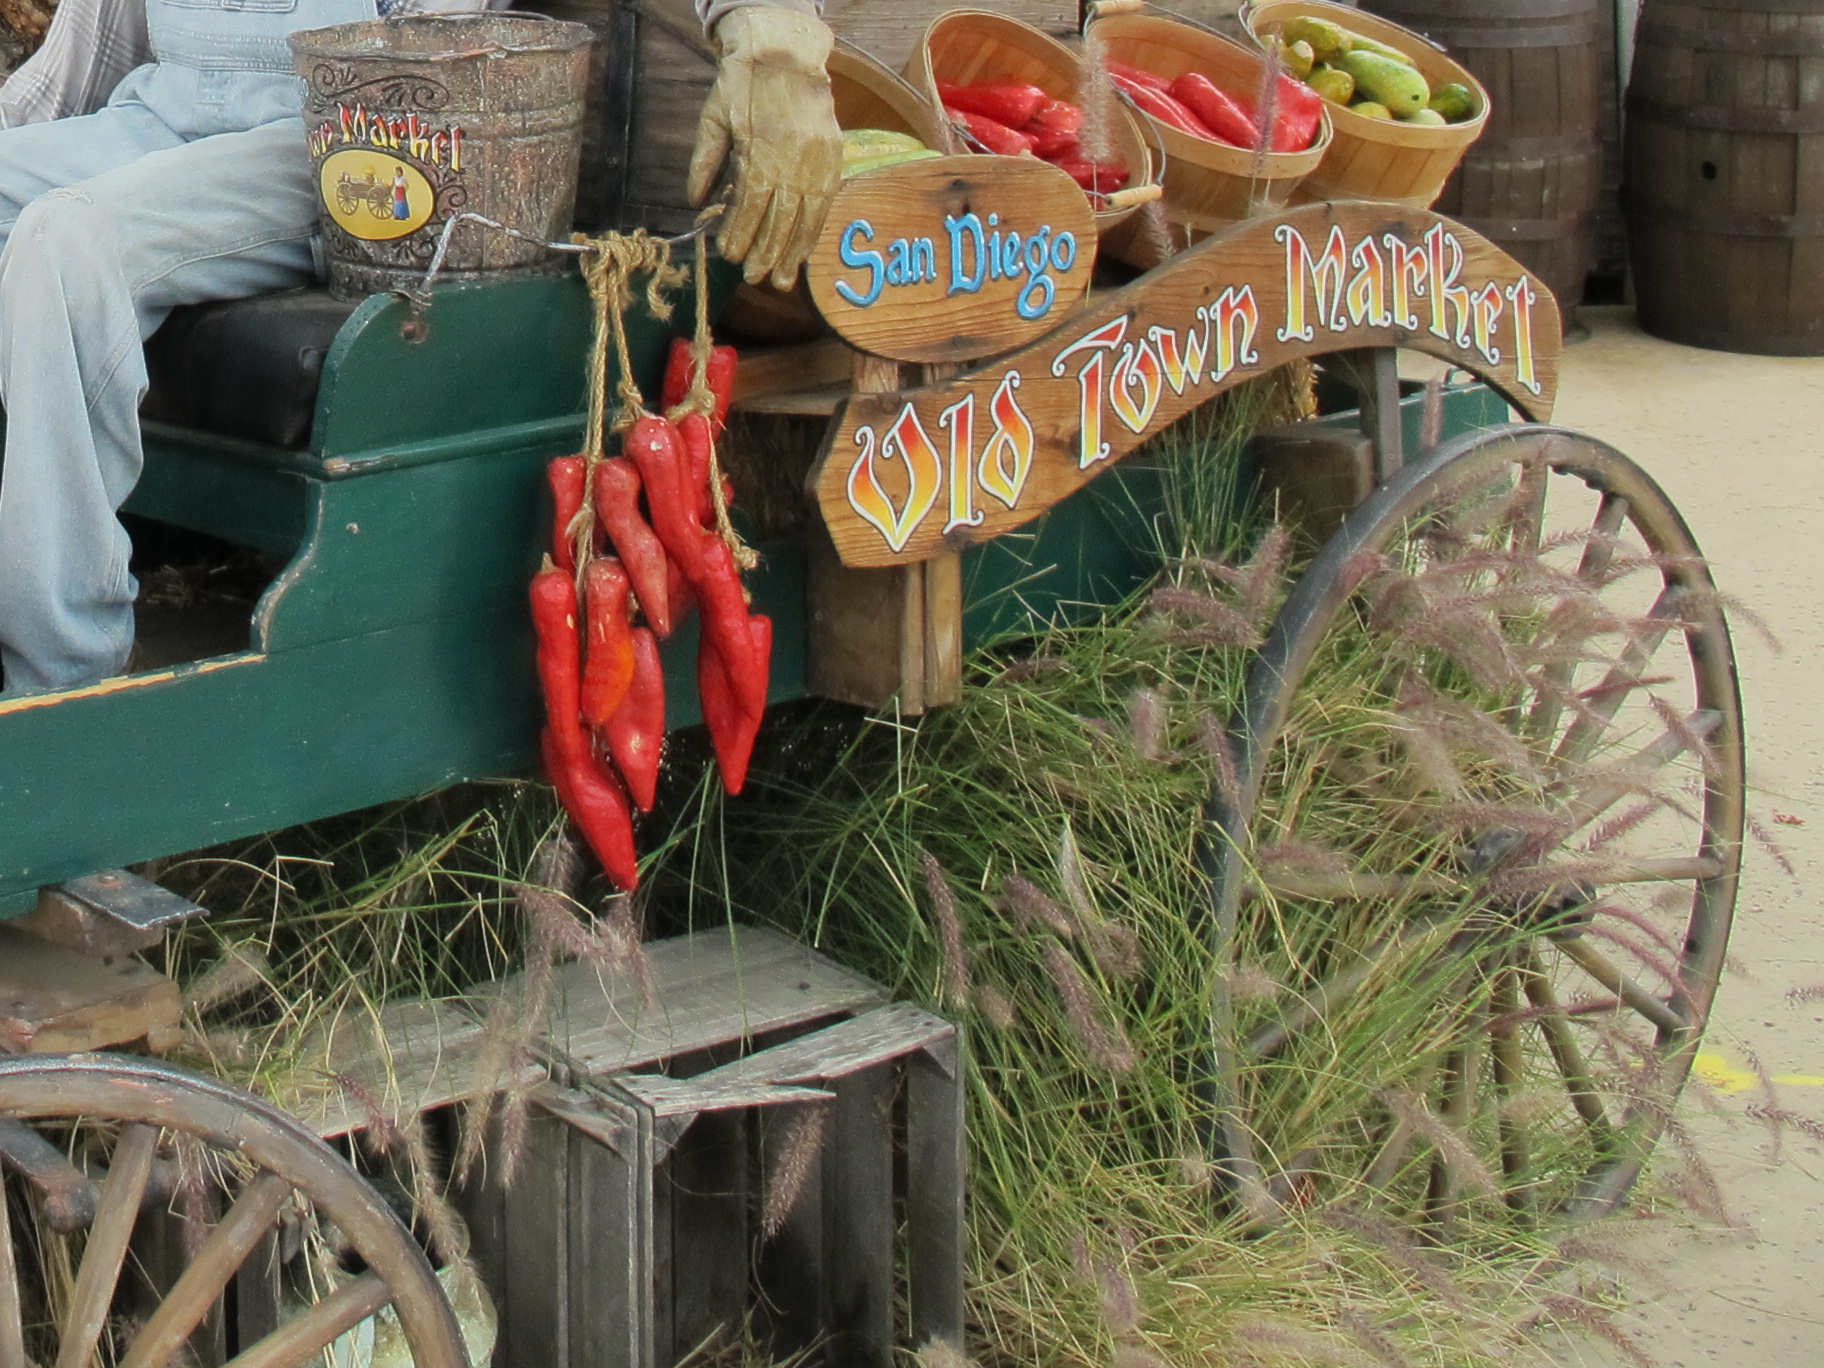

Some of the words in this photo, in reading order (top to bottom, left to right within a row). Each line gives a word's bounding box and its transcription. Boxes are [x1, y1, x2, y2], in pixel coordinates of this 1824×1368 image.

[334, 101, 466, 173] Market
[834, 218, 937, 309] San
[947, 212, 1077, 321] Diego
[846, 369, 1035, 554] Old
[1051, 281, 1259, 471] Town
[1274, 220, 1543, 397] Market
